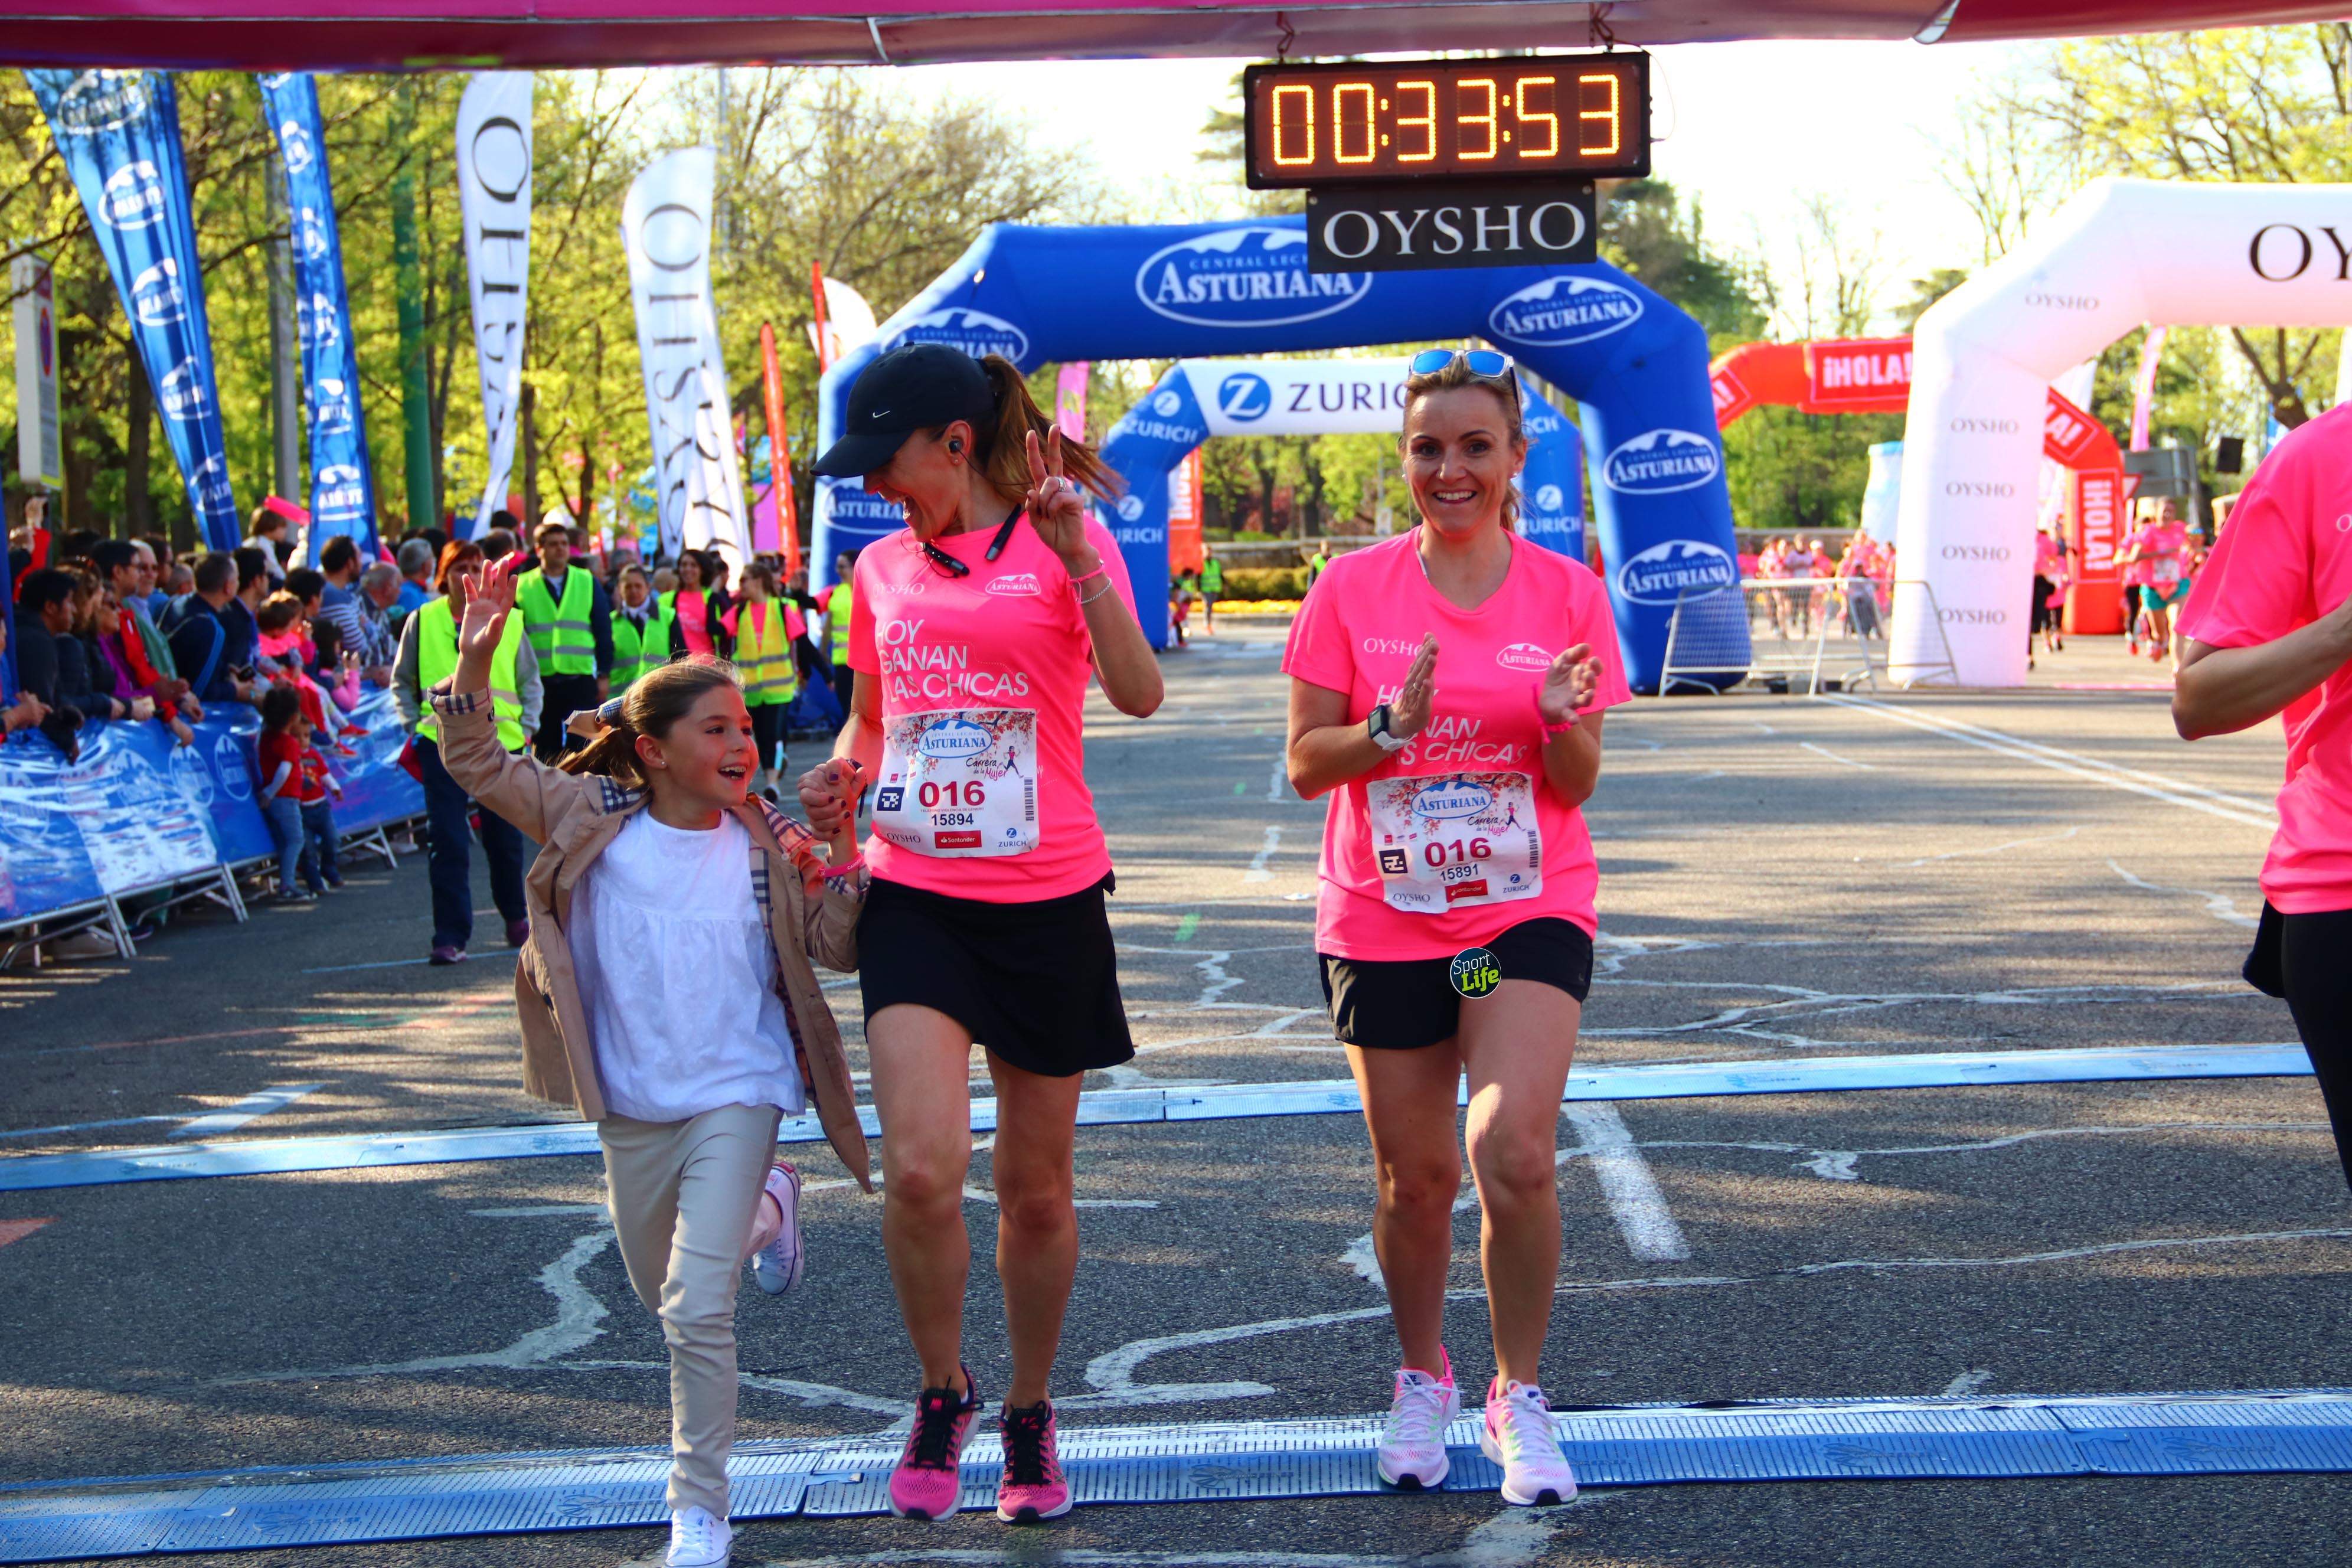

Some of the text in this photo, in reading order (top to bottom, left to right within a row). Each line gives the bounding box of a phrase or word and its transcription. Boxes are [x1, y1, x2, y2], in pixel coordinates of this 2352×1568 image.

[1272, 74, 1619, 165] 00:33:53
[1323, 201, 1586, 259] OYSHO
[1189, 255, 1264, 270] CENTRAL
[1154, 261, 1356, 304] ASTURIANA
[2024, 292, 2100, 311] OYSHO
[1504, 300, 1634, 336] ASTURIANA
[1822, 352, 1912, 388] ¡HOLA!
[1122, 419, 1198, 443] ZURICH
[1950, 417, 2020, 436] OYSHO
[1613, 454, 1714, 485] ASTURIANA
[1946, 481, 2014, 499] OYSHO
[825, 491, 904, 520] ASTURIA
[2083, 479, 2113, 571] ¡HOLA!
[1110, 527, 1163, 544] URICH
[1941, 544, 2011, 563] OYSHO
[989, 582, 1038, 593] ASTURIANA
[1627, 564, 1729, 596] ASTURIANA
[1938, 608, 2007, 626] OYSHO
[876, 619, 925, 646] HOY
[879, 645, 967, 674] GANAN
[1502, 652, 1551, 667] ASTURIANA
[886, 671, 1029, 703] LAS CHICAS
[1425, 715, 1482, 740] NAN
[922, 736, 986, 751] ASTURIANA
[1424, 740, 1528, 766] CHICAS
[966, 757, 997, 767] Carrera
[984, 769, 1008, 781] Mujer
[919, 780, 985, 807] 016
[1417, 796, 1487, 812] ASTURIANA
[931, 813, 974, 826] 15894
[1468, 816, 1498, 825] Carrera
[887, 832, 921, 844] OYSHO
[1488, 825, 1509, 836] Mujer
[1425, 837, 1491, 867] 016
[1440, 864, 1479, 881] 15891
[1393, 893, 1430, 903] OYSHO
[1455, 886, 1482, 894] antander
[1502, 884, 1530, 893] ZURICH
